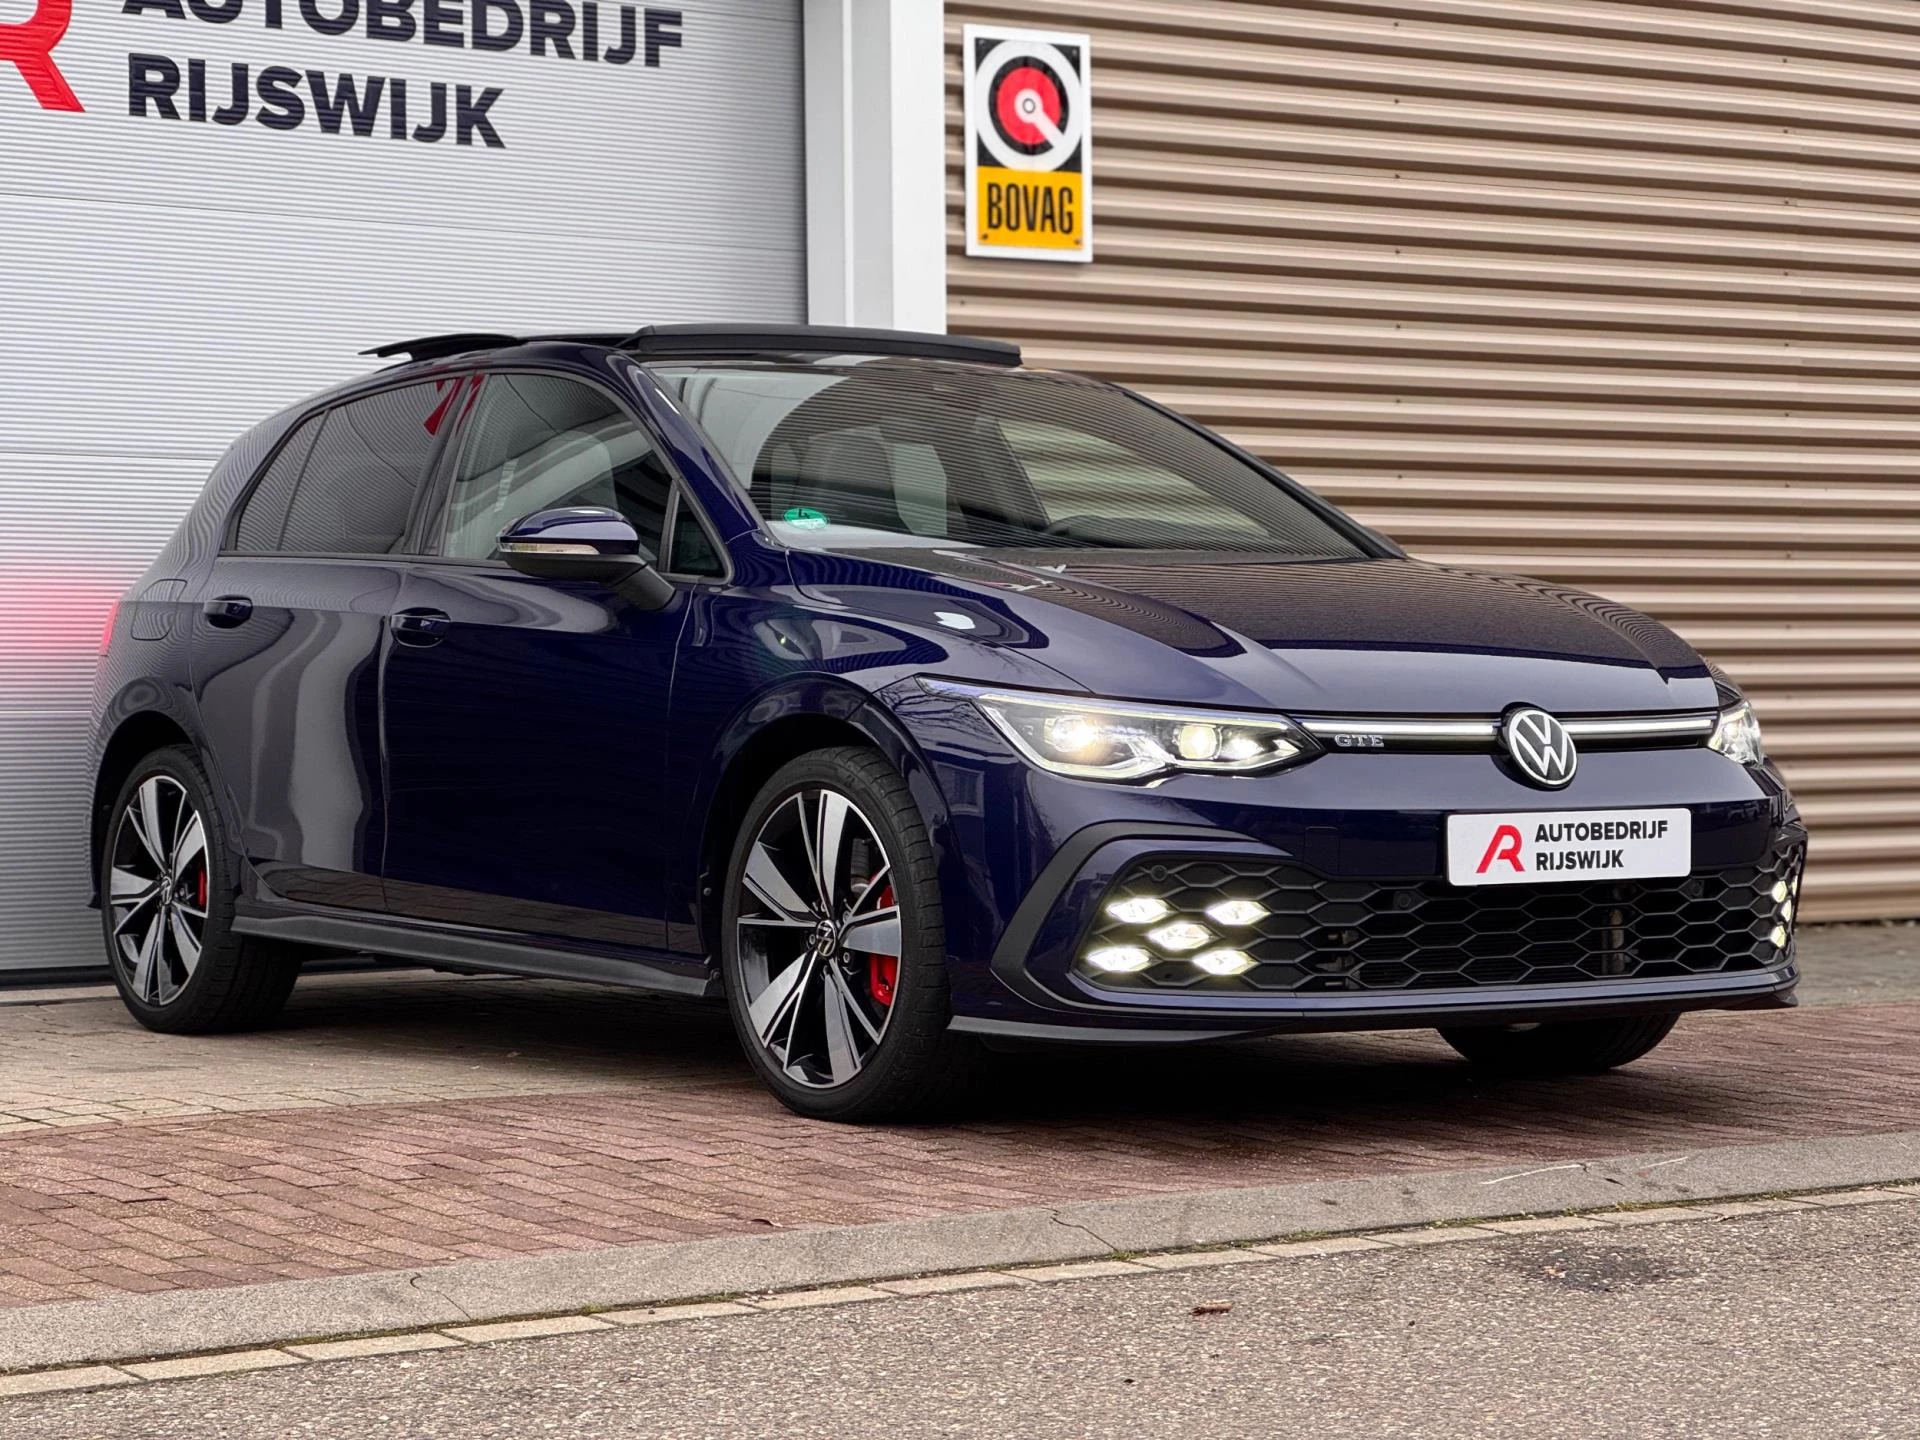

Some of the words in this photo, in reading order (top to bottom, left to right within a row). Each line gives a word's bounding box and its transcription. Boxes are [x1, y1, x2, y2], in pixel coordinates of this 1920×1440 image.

[122, 0, 683, 68] OBEDRIJF
[128, 53, 506, 148] RIJSWIJK
[987, 182, 1074, 235] BOVAG
[1334, 733, 1385, 748] GTE
[1534, 819, 1669, 842] AUTOBEDRIJF
[1535, 849, 1624, 871] RIJSWIJK
